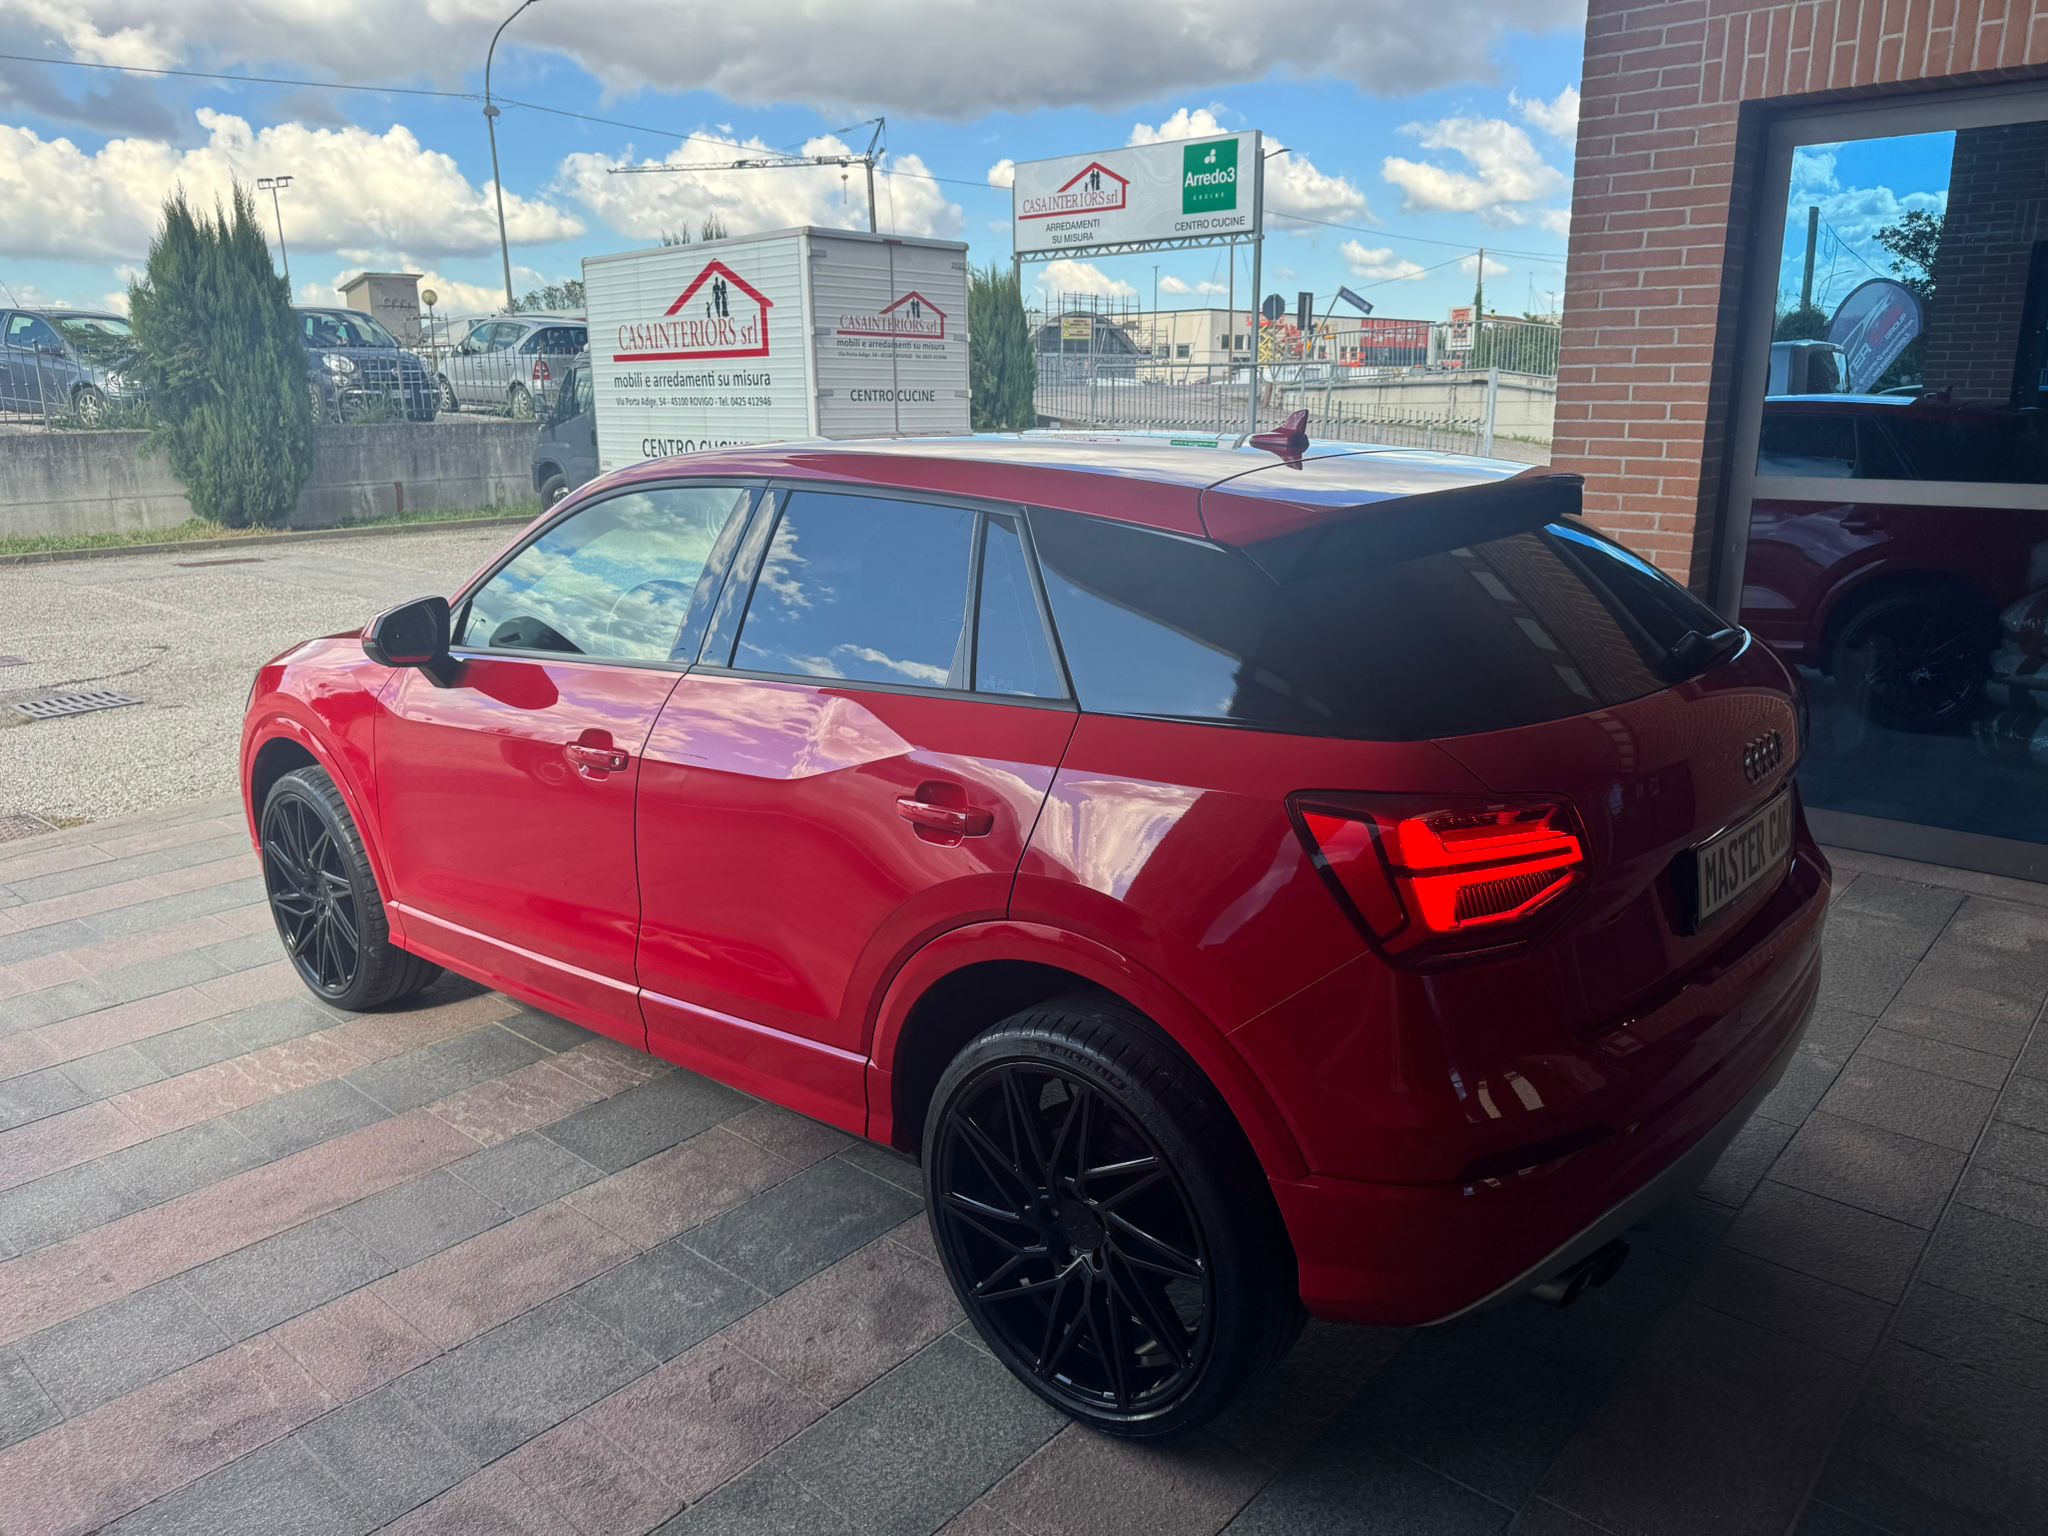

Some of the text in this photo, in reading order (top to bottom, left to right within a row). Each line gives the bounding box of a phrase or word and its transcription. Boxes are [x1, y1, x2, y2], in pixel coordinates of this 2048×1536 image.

[1184, 166, 1236, 188] Arredo3
[1106, 188, 1119, 206] srl
[1045, 218, 1100, 233] ARREDAMENTI
[1174, 216, 1246, 232] CENTRO CUCINE
[1051, 232, 1094, 245] SU MISURA
[618, 314, 758, 350] CASAINTERIORS srl
[840, 314, 937, 334] CASAINTERIORS srl
[837, 338, 860, 347] mobili
[868, 339, 911, 349] arredamenti
[923, 341, 945, 350] misura
[614, 369, 771, 388] mobili e arredamenti su misura
[616, 397, 624, 406] Via
[625, 397, 640, 406] Porta
[659, 397, 666, 406] 54
[671, 397, 688, 406] 45100
[690, 397, 713, 406] ROVIGO
[731, 397, 746, 406] 0425
[748, 397, 772, 406] 412946
[850, 388, 936, 402] CENTRO CUCINE
[642, 438, 695, 457] CENTRO
[1704, 799, 1790, 908] MASTER CAR
[1054, 1046, 1124, 1090] MICHELIN
